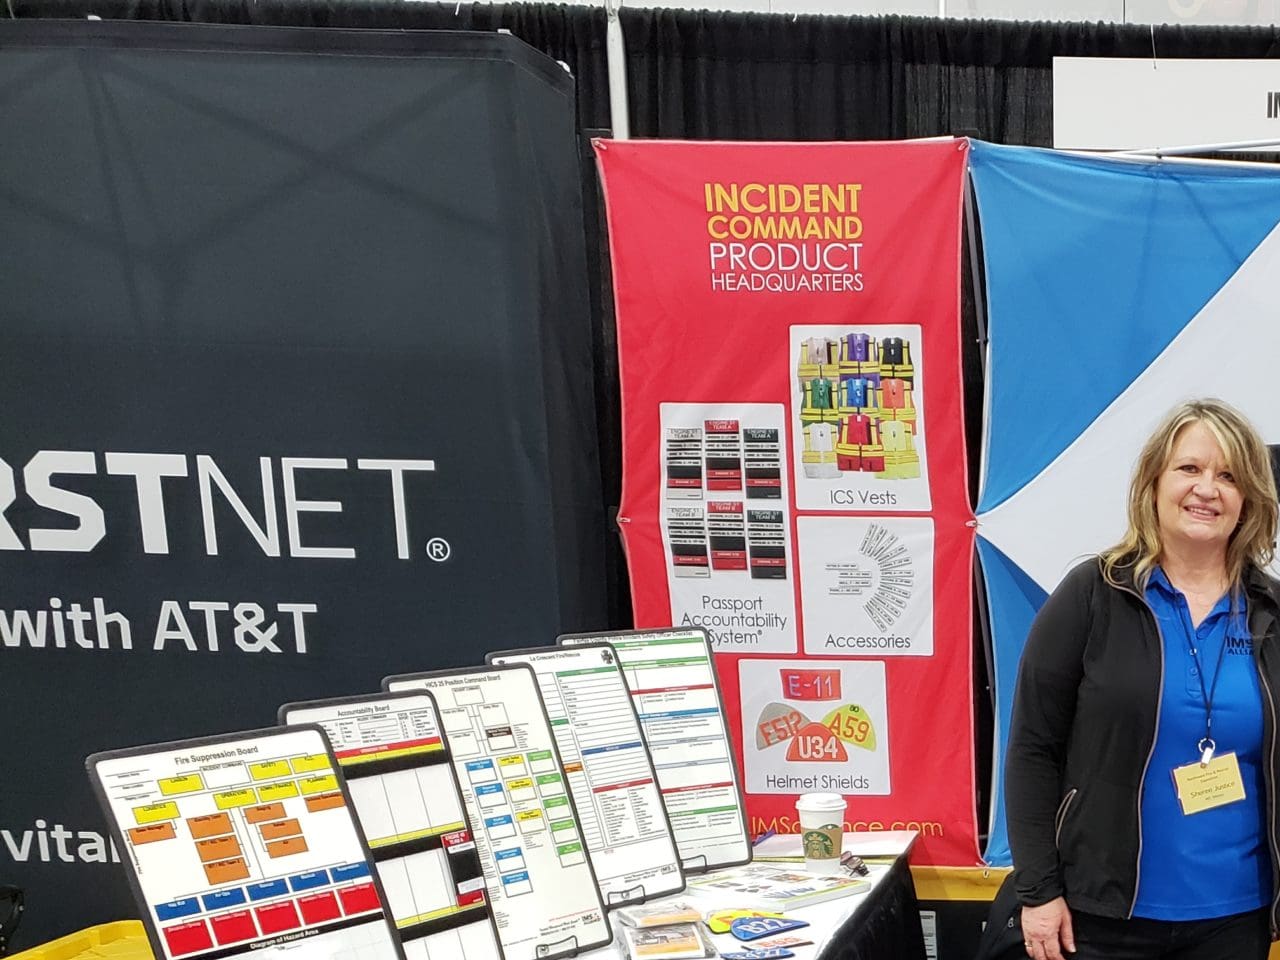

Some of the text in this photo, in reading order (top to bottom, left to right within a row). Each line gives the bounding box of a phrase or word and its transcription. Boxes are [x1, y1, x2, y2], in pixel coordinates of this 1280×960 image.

[704, 183, 862, 213] INCIDENT
[707, 215, 863, 240] COMMAND
[709, 242, 863, 271] PRODUCT
[711, 273, 864, 292] HEADQUARTERS
[830, 490, 897, 506] ICS Vests
[702, 595, 763, 613] Passport
[0, 597, 318, 654] with AT&T
[681, 612, 787, 631] Accountability
[825, 634, 911, 649] Accessories
[788, 675, 832, 697] E-11
[337, 704, 390, 718] Accountability Board
[828, 712, 870, 743] A59
[174, 745, 259, 766] Fire Suppression Board
[797, 735, 839, 759] U34
[766, 774, 870, 789] Helmet Shields
[736, 918, 793, 934] B22
[250, 938, 276, 950] Diagram
[284, 932, 304, 942] Hazard
[305, 928, 319, 936] Area
